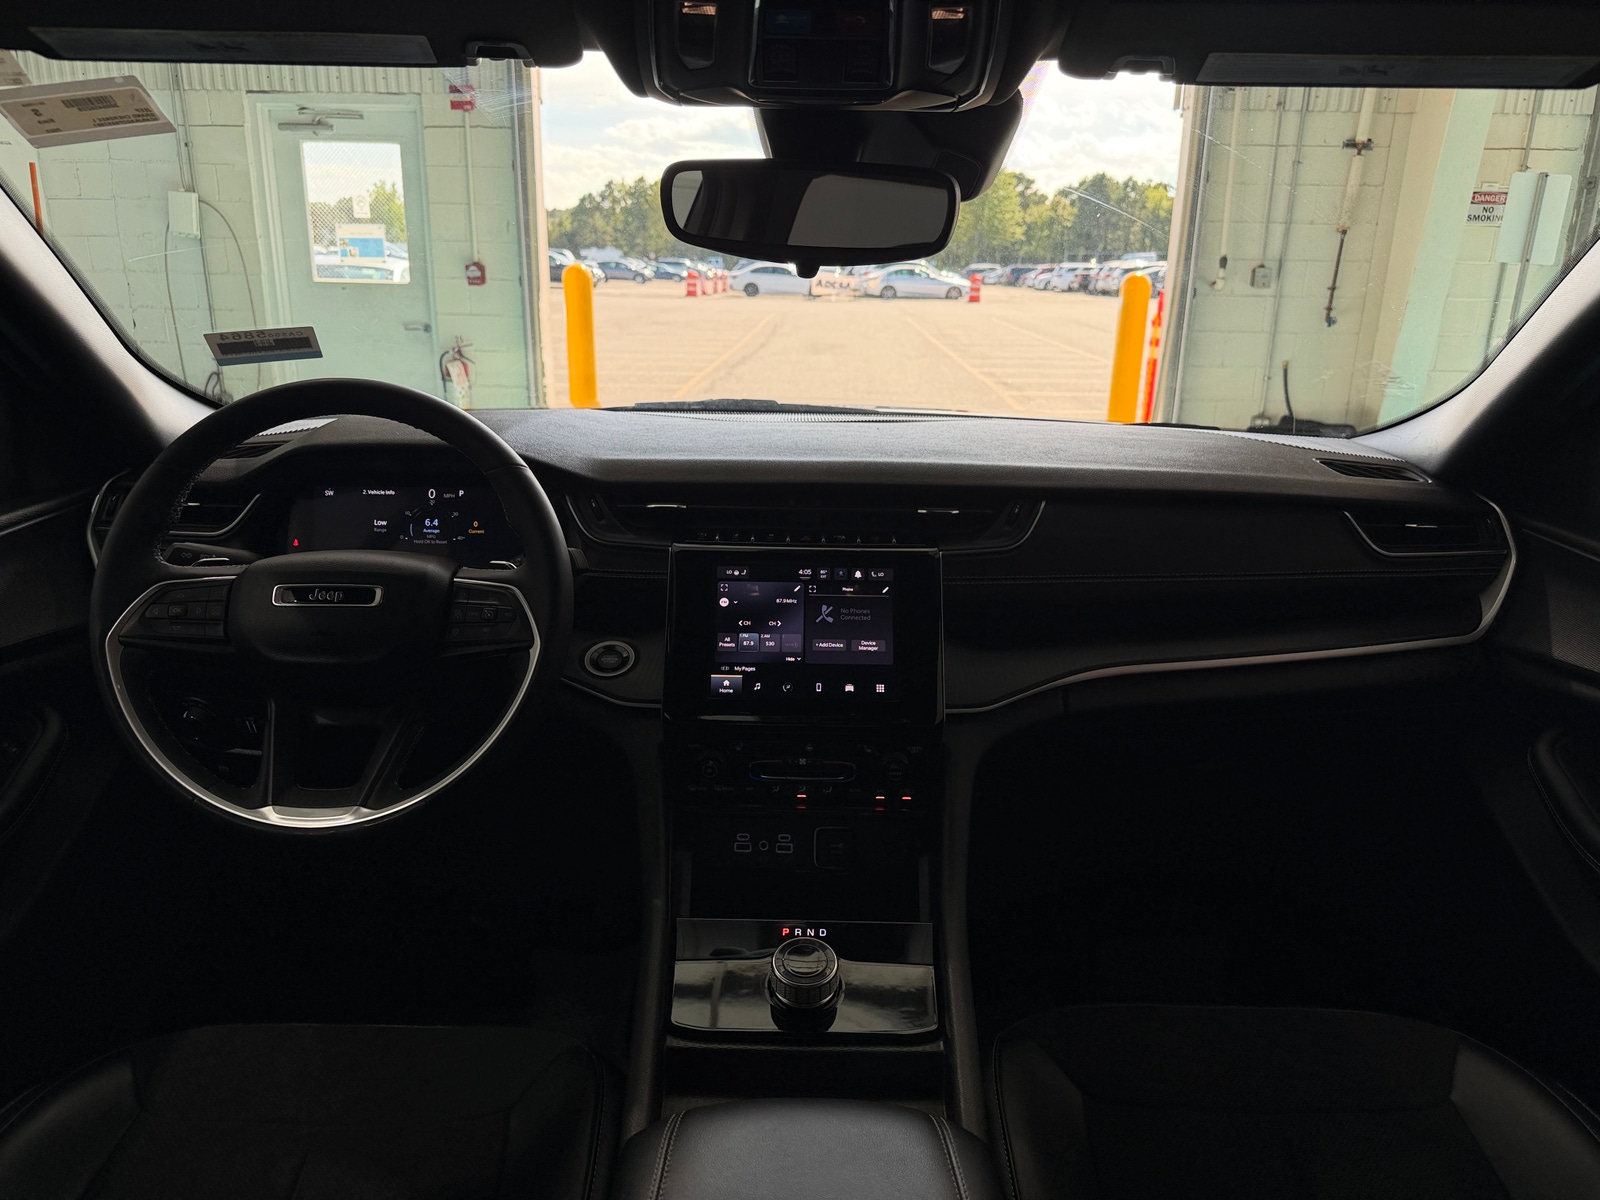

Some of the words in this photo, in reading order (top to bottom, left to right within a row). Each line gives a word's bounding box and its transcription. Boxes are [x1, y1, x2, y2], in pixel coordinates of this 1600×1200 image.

[1474, 194, 1506, 203] DANGER
[1482, 206, 1495, 214] NO
[1466, 214, 1504, 222] SMOKIN
[324, 489, 335, 497] SW
[428, 488, 436, 499] 0
[459, 489, 465, 497] P
[424, 518, 440, 527] 6.4
[798, 568, 812, 576] 4:05
[308, 588, 345, 602] Jeep
[782, 927, 790, 937] P
[794, 928, 802, 937] R
[806, 928, 815, 937] N
[819, 928, 827, 937] D
